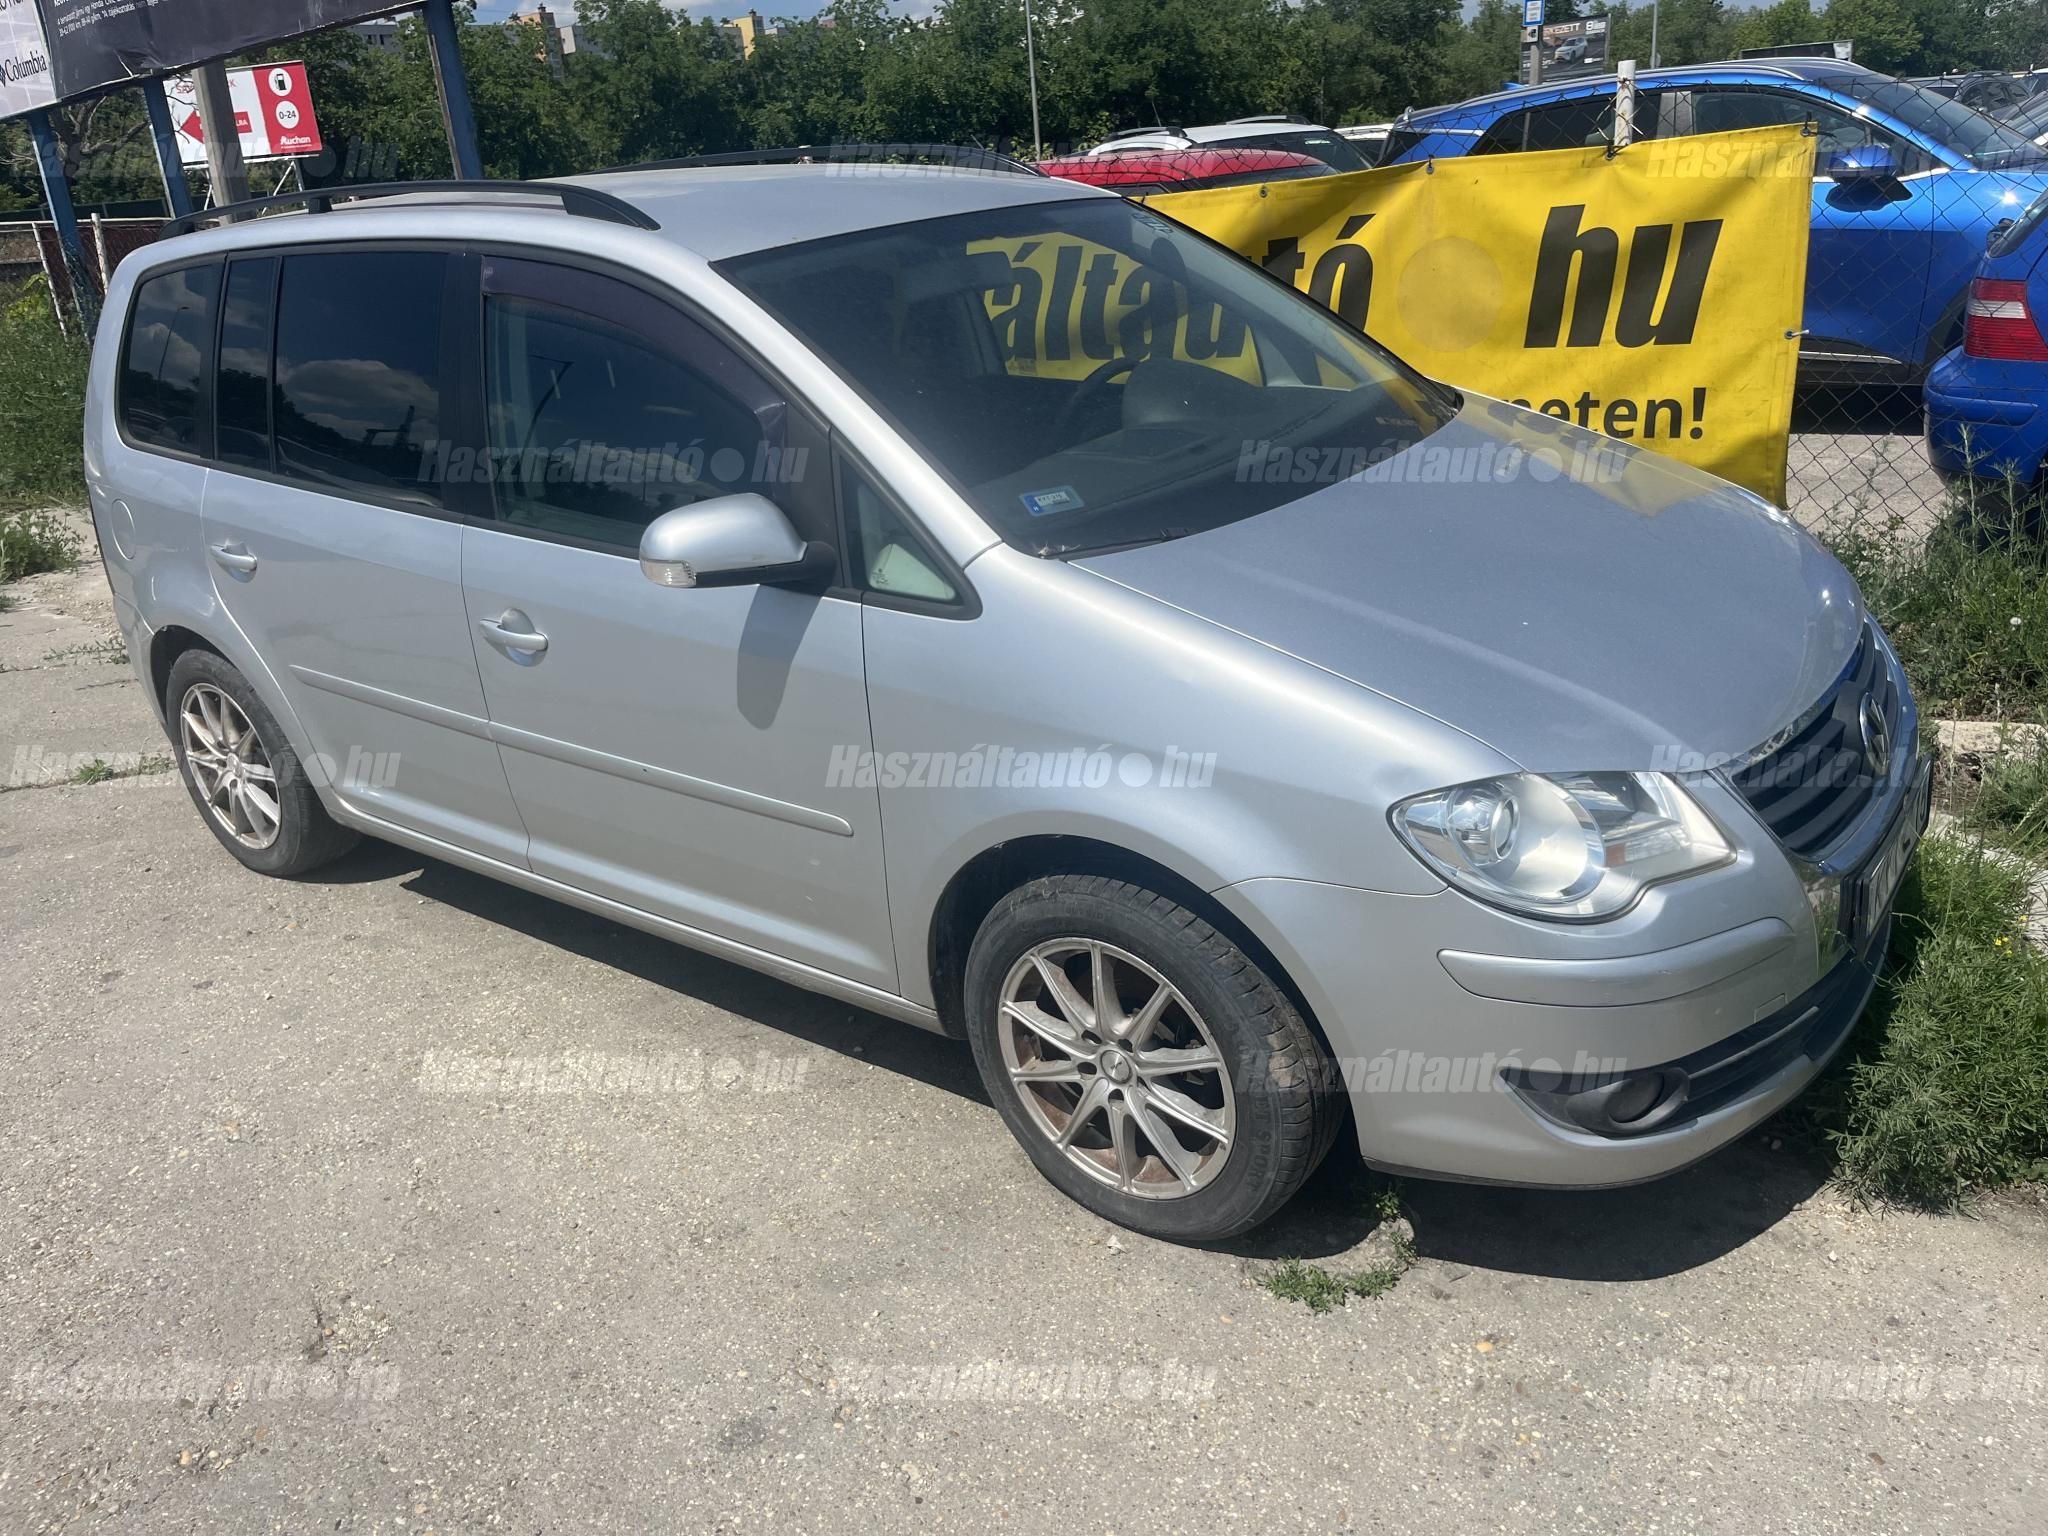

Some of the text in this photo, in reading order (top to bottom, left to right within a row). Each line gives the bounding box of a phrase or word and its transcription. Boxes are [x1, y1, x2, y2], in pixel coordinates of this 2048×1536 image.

[5, 51, 48, 81] Columbia
[278, 110, 297, 120] 0-24
[280, 135, 311, 145] Auchan
